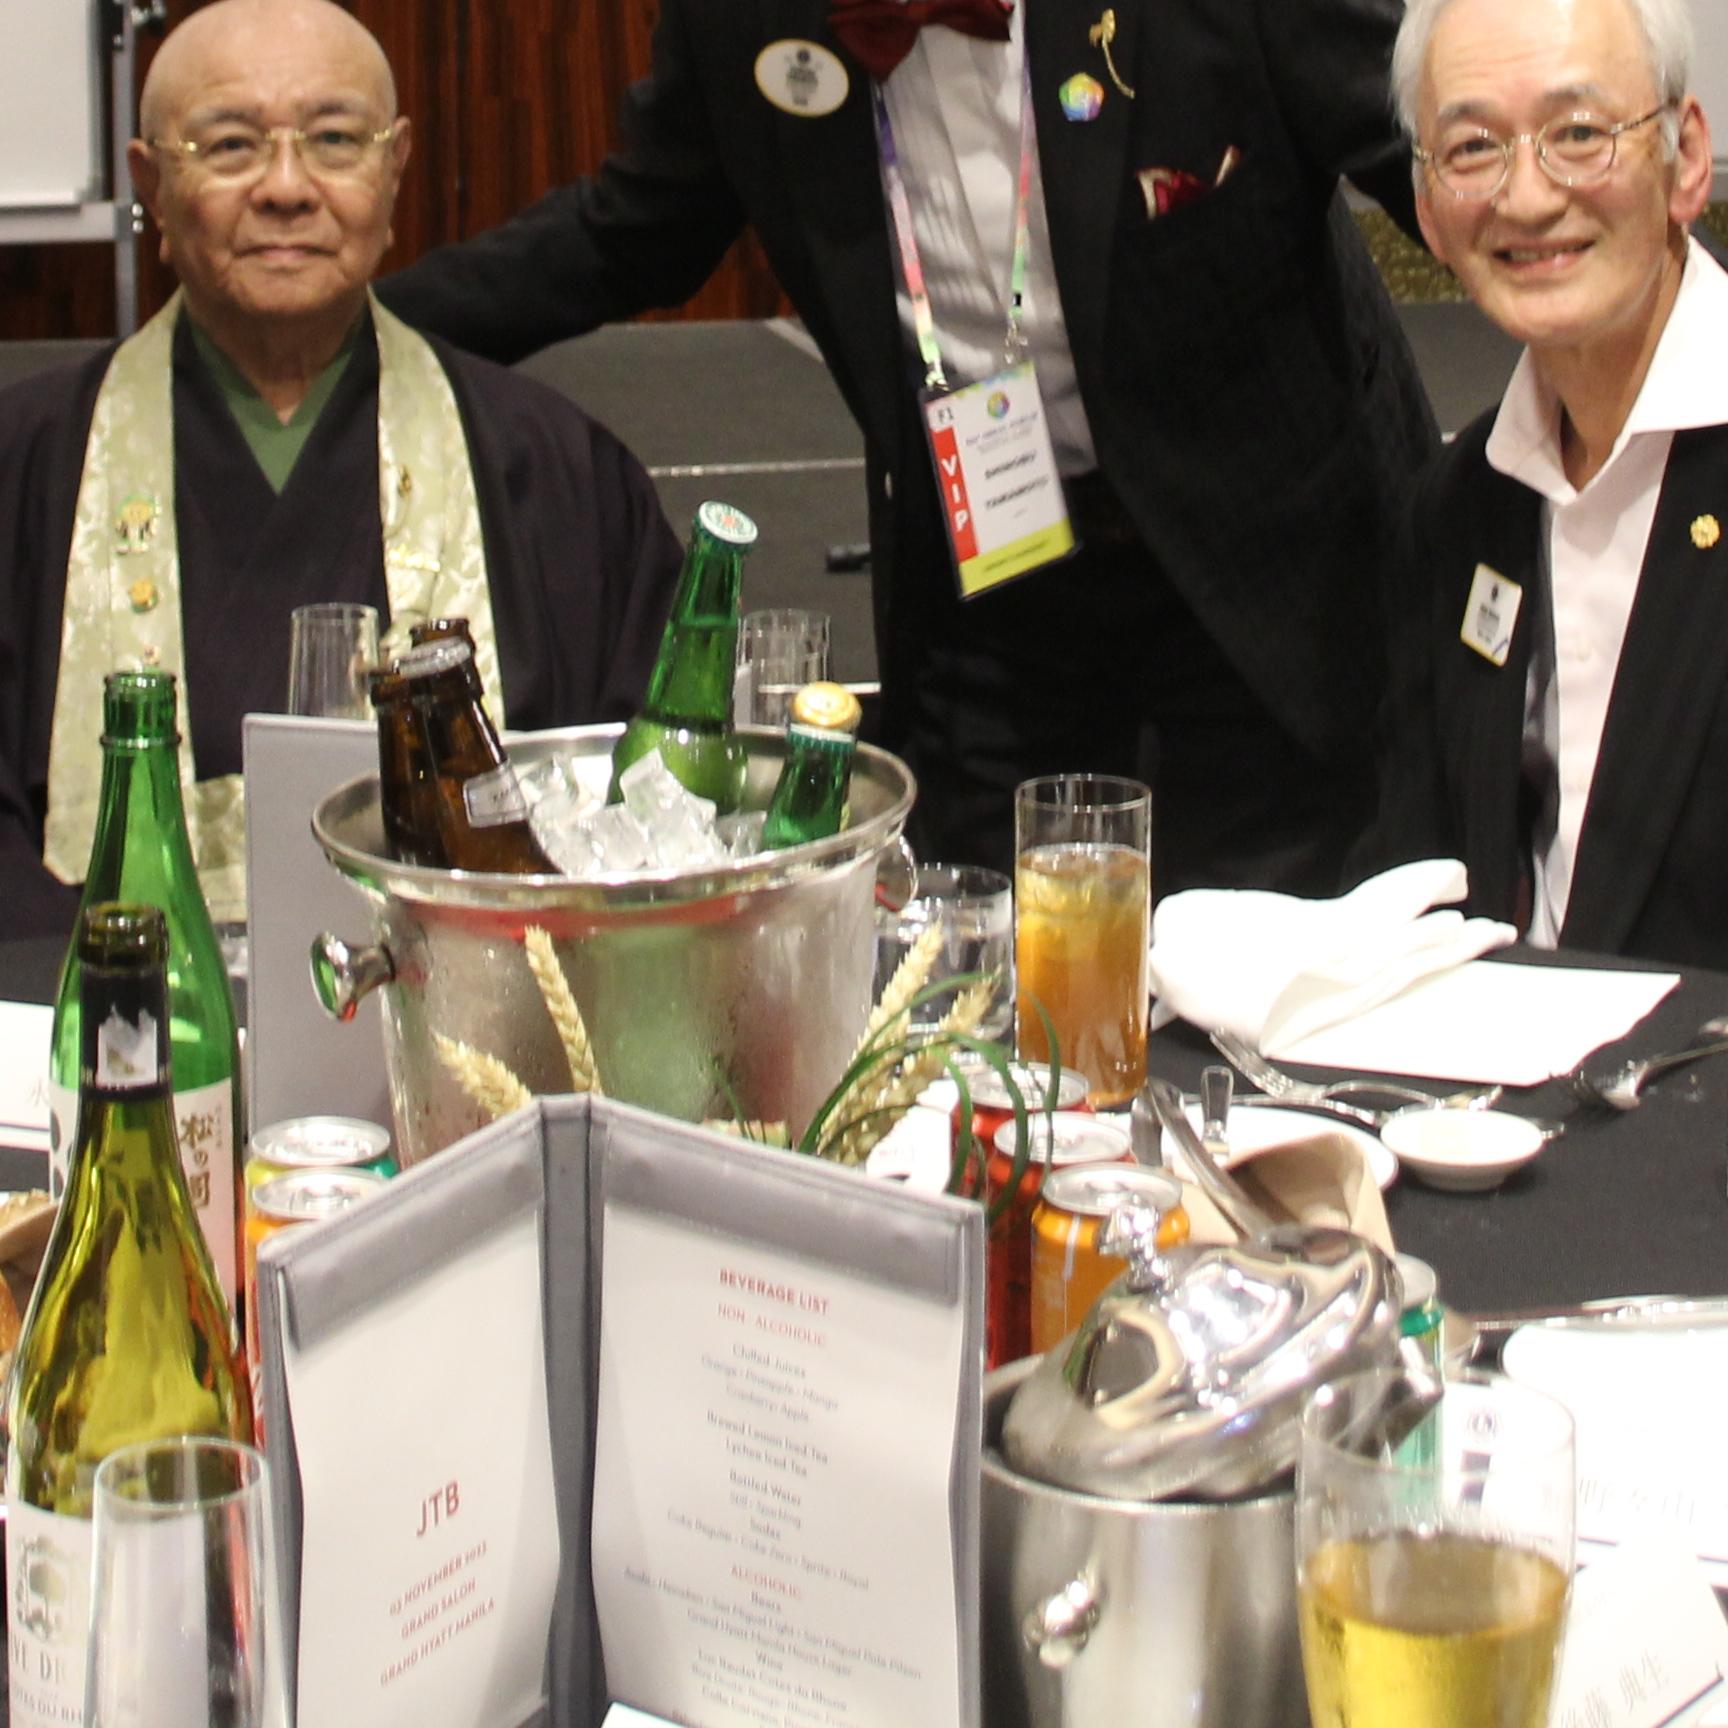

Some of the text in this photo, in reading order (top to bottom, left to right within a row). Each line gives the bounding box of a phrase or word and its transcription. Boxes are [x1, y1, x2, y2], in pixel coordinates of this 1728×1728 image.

[941, 453, 969, 533] VIP
[719, 1269, 828, 1312] BEVERAGE LIST
[416, 1480, 460, 1537] JTB
[401, 1577, 477, 1640] GRAND SALON
[403, 1556, 462, 1605] NOVEMBER
[380, 1596, 495, 1687] GRAND HYATT MANILA
